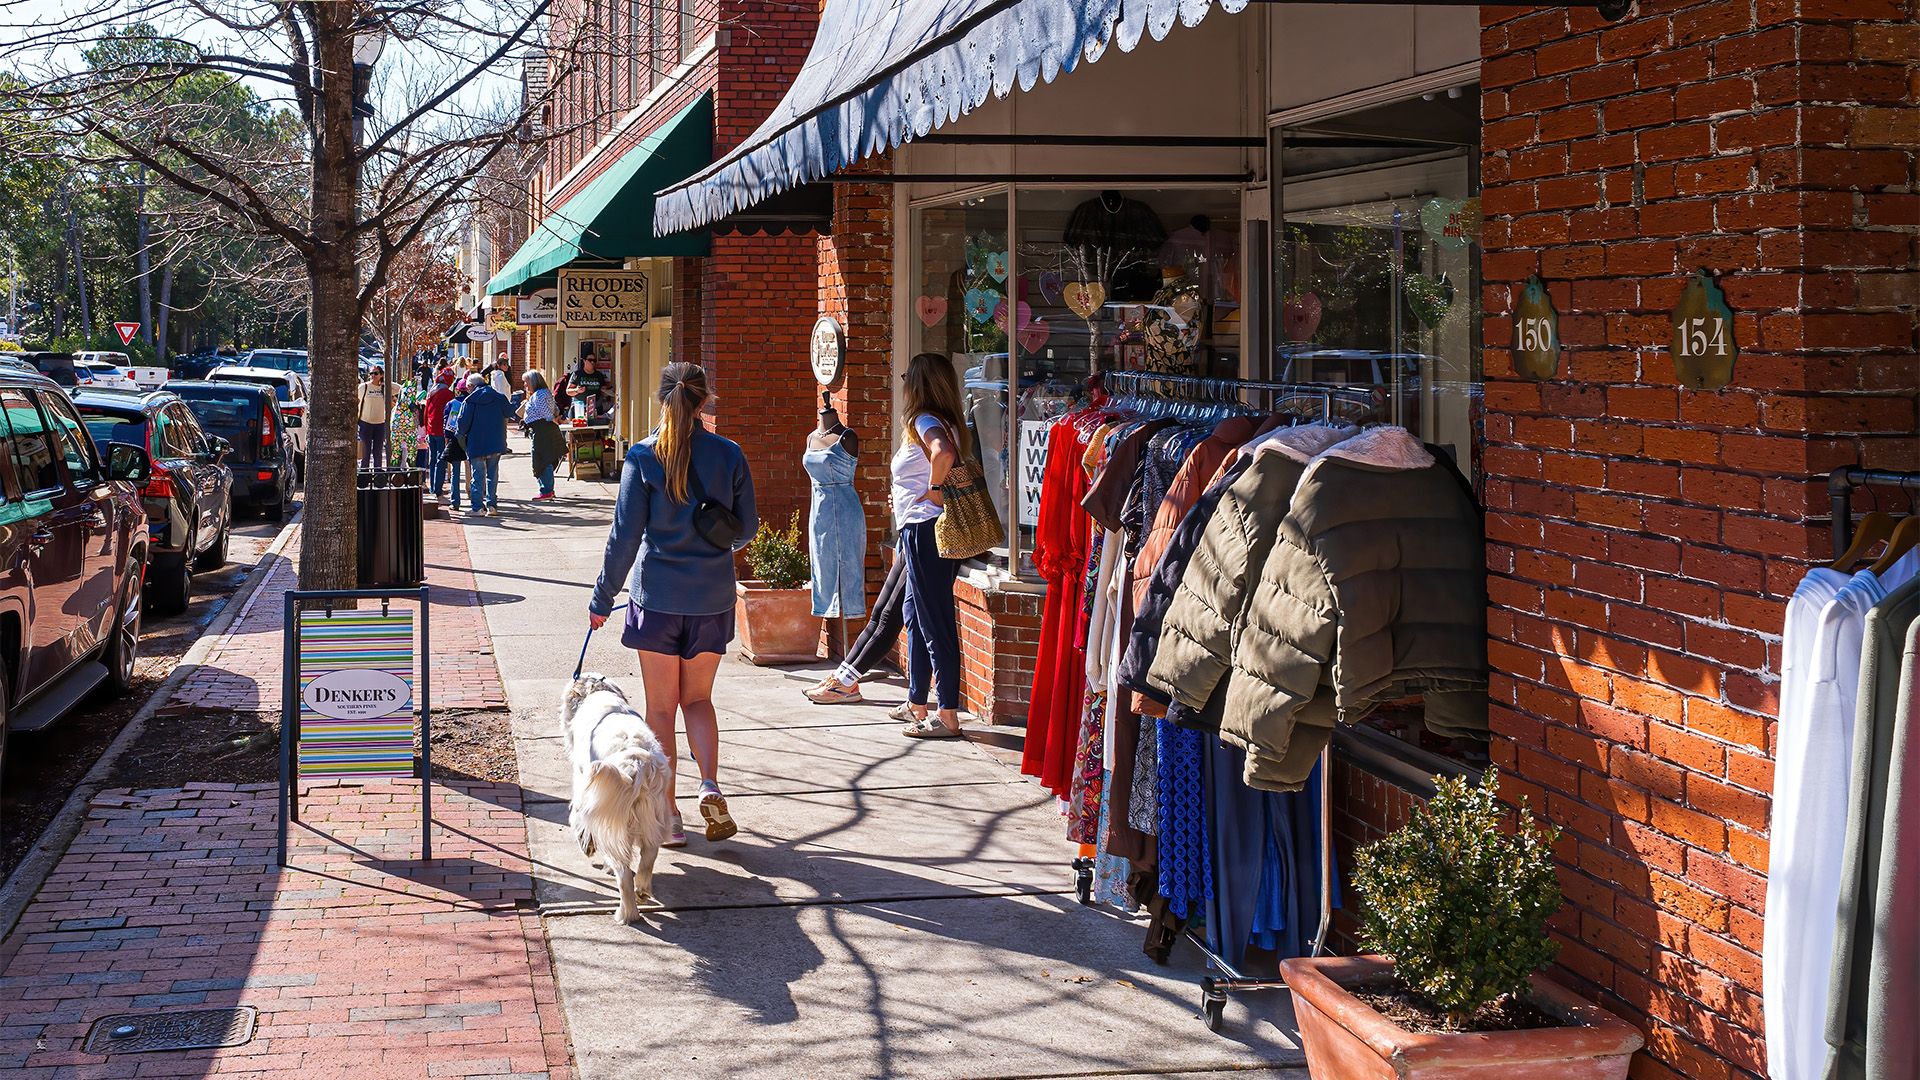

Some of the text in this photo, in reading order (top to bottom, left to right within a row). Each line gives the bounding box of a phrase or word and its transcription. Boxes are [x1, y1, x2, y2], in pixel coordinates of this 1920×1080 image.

[566, 278, 643, 292] RHODES
[566, 294, 624, 309] & CO.
[566, 311, 643, 321] REAL ESTATE
[1515, 317, 1552, 352] 150
[1678, 317, 1728, 357] 154
[315, 687, 396, 703] DENKER'S
